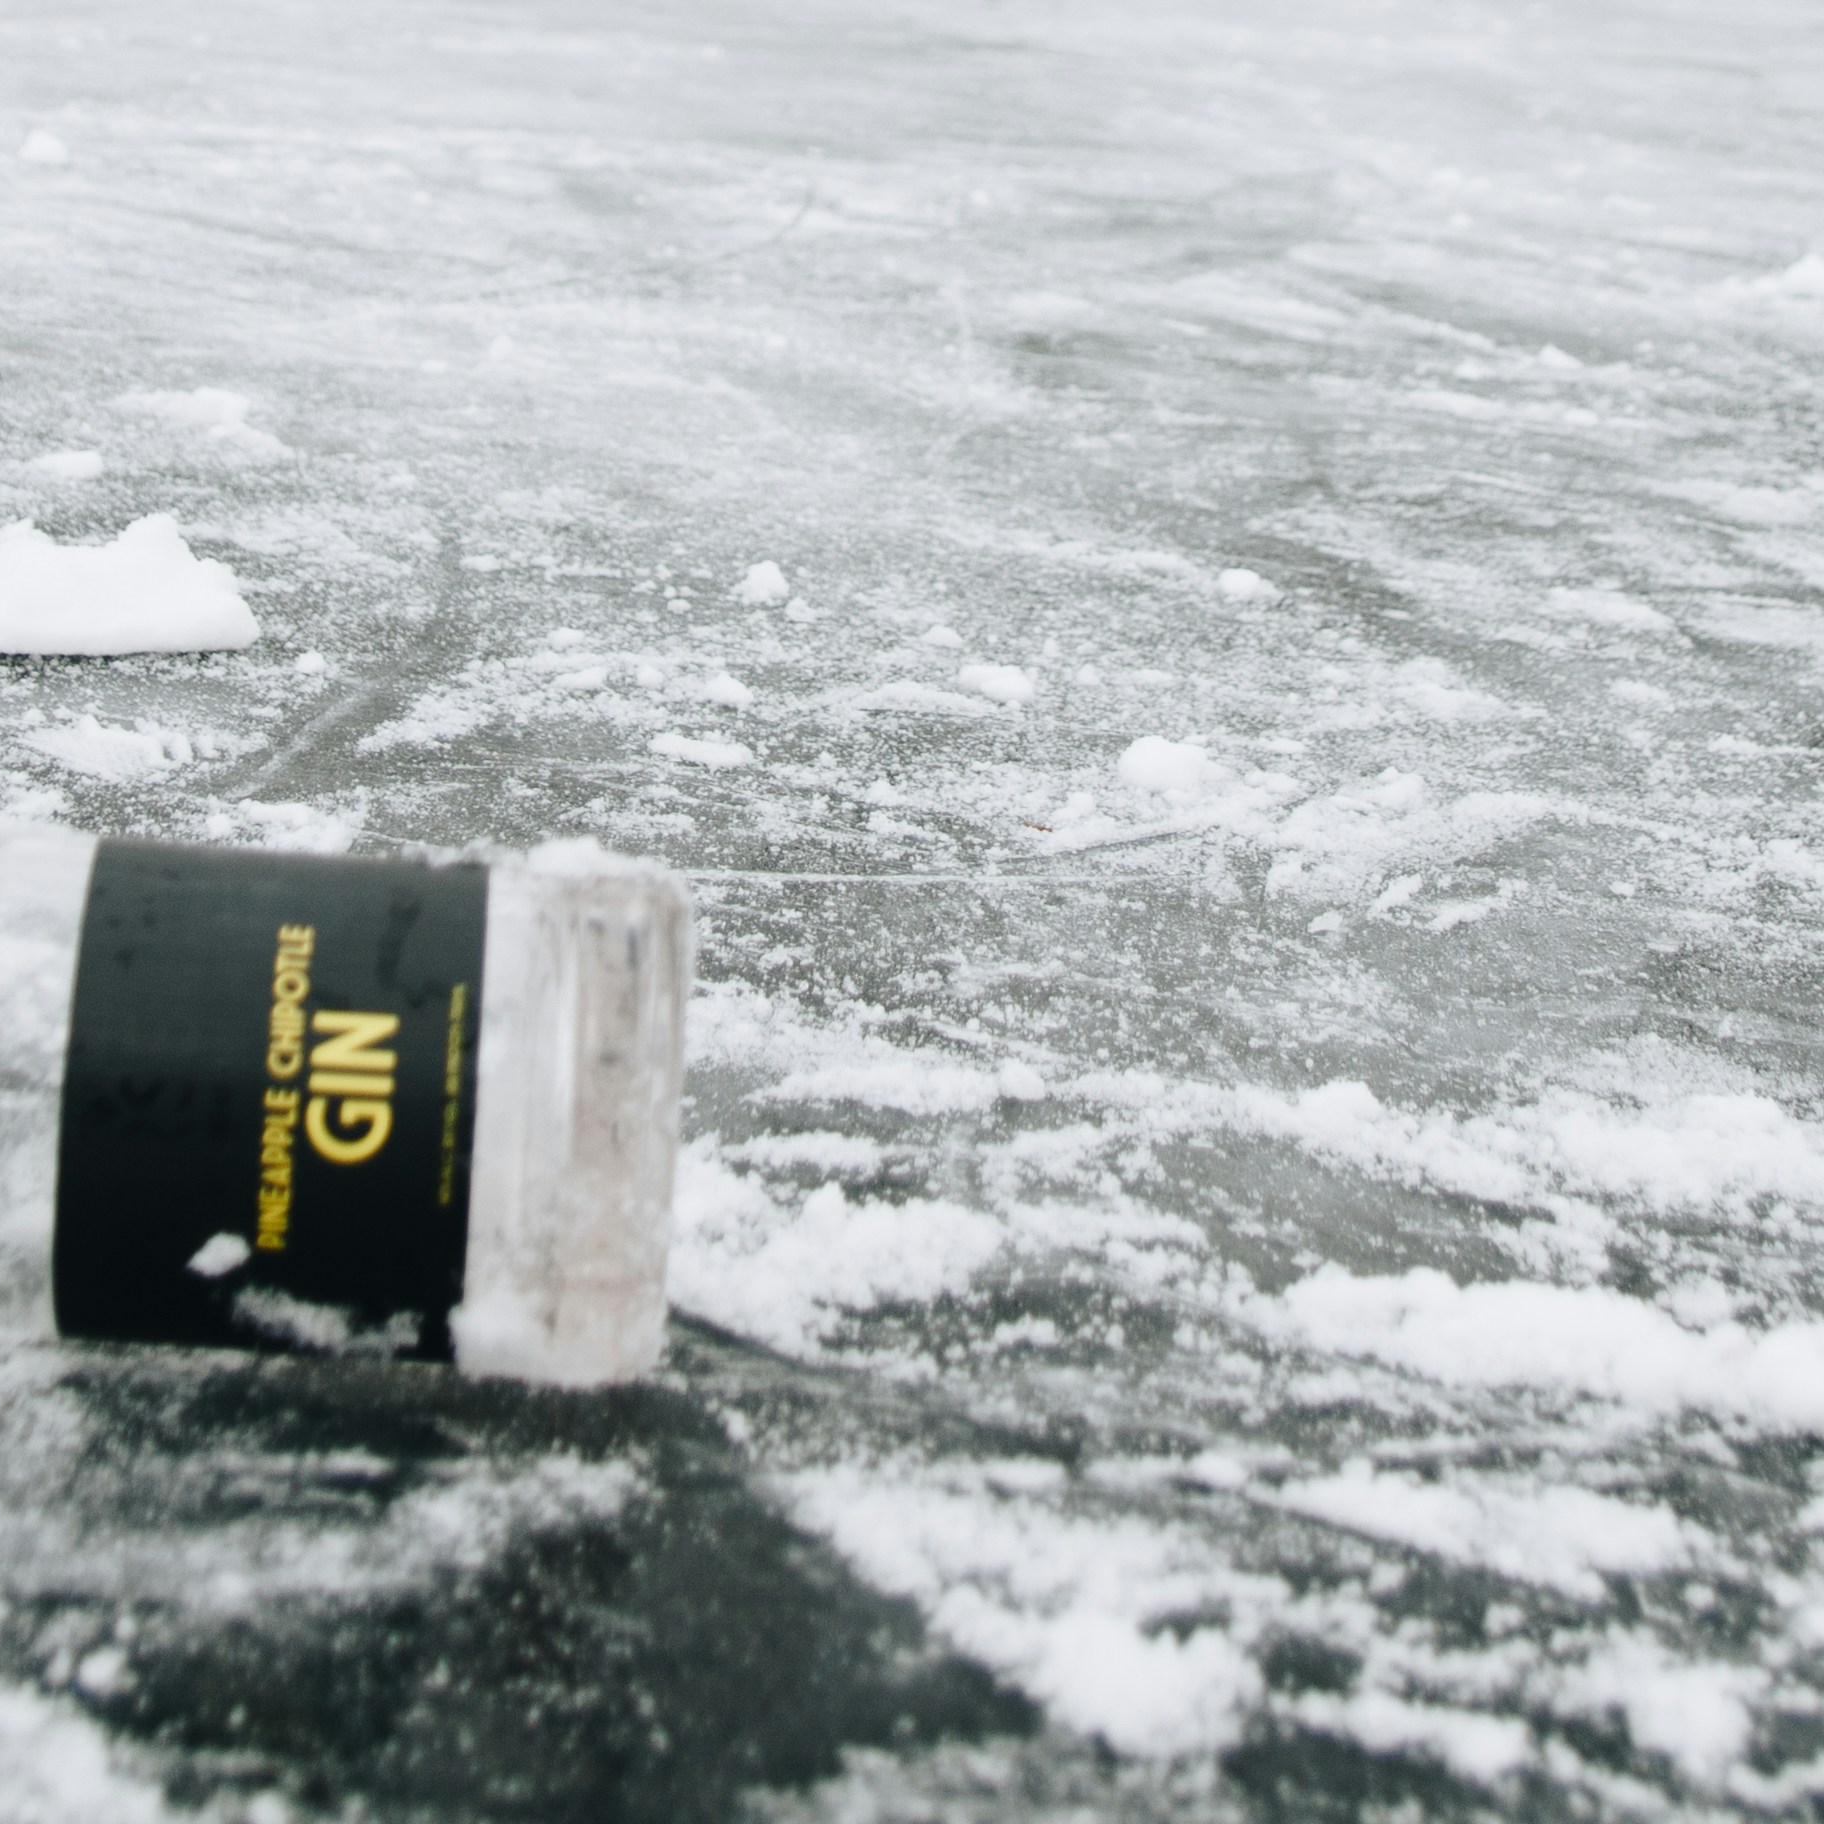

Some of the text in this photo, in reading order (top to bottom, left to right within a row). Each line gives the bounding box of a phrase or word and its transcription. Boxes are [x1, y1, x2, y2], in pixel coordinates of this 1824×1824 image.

[257, 925, 315, 1250] PINEAPPLE CHIPOTLE
[304, 1009, 400, 1165] GIN
